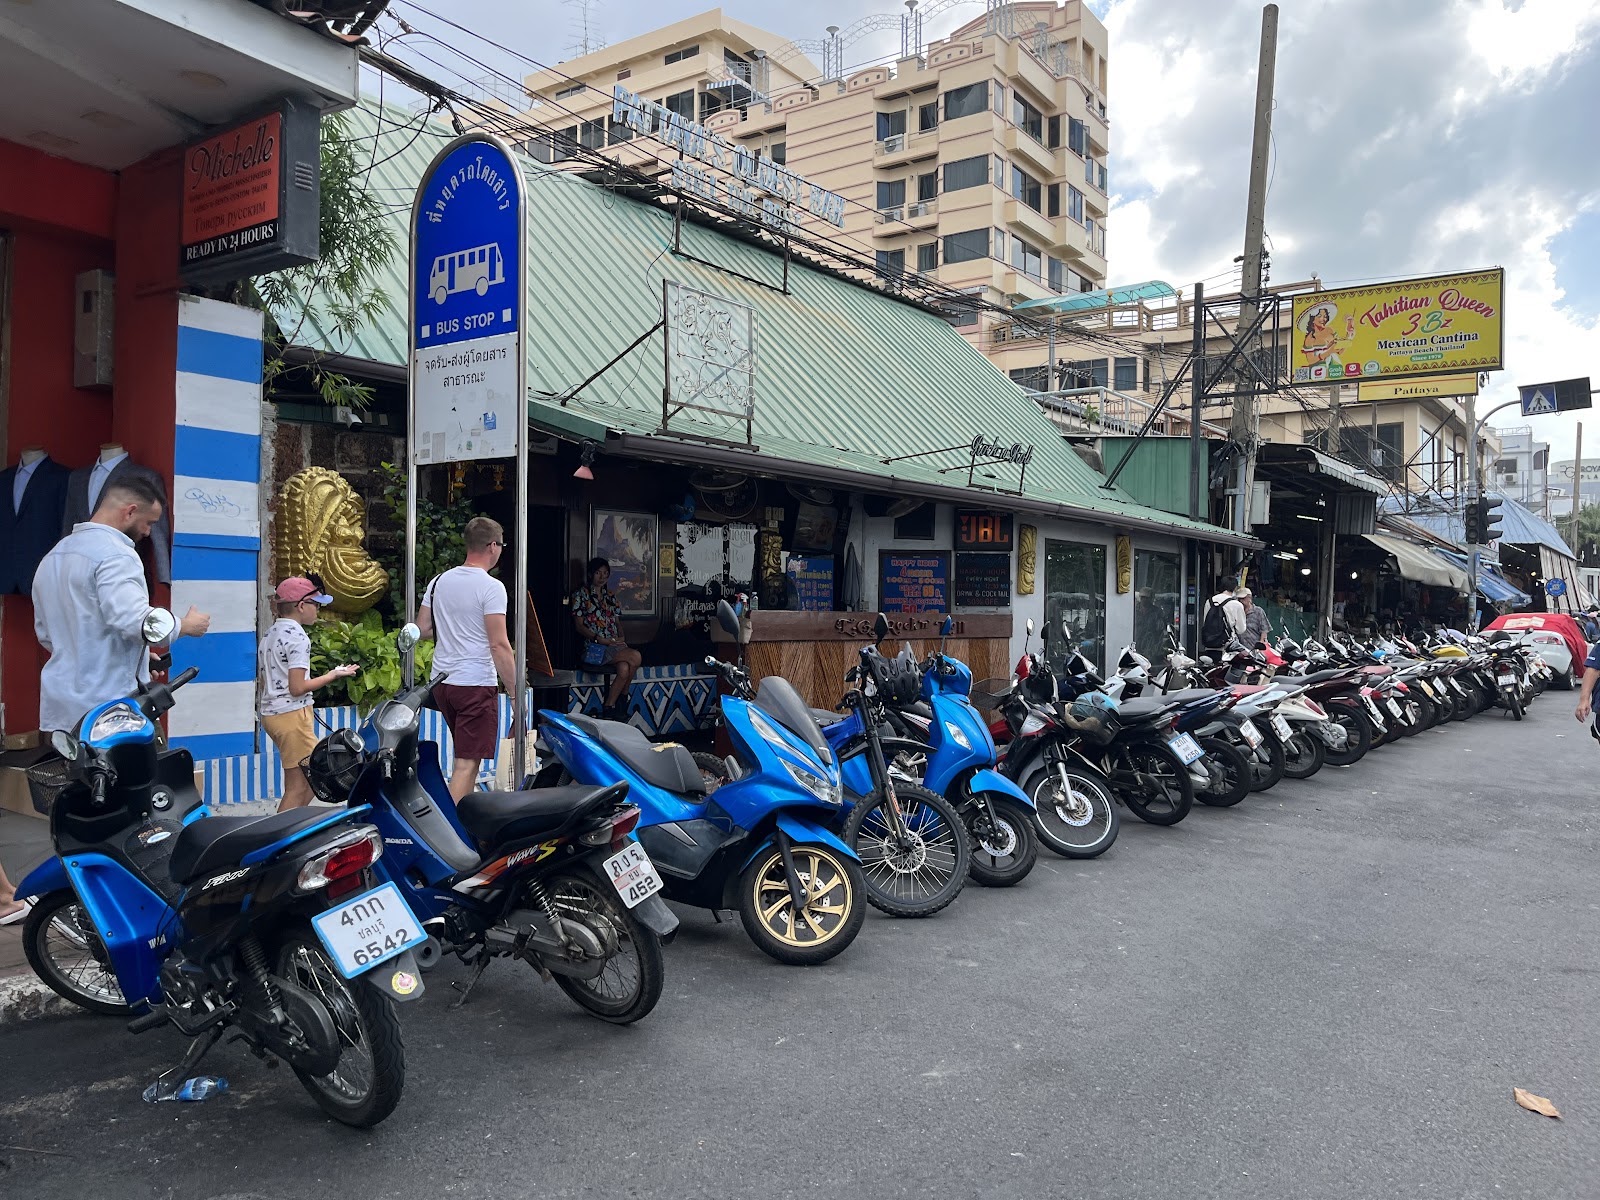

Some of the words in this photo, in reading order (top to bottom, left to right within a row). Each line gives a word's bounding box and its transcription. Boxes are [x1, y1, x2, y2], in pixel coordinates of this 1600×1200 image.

[191, 122, 274, 190] Michelle
[187, 240, 217, 261] READY
[218, 236, 229, 251] IN
[229, 233, 239, 250] 24
[240, 223, 274, 246] HOURS
[1359, 295, 1433, 328] Tahitian
[1438, 288, 1496, 318] Queen
[436, 318, 460, 336] BUS
[464, 311, 495, 331] STOP
[1377, 336, 1428, 350] Mexican
[1430, 331, 1480, 344] Cantina
[1389, 349, 1413, 357] Pattaya
[1414, 346, 1434, 354] Beach
[1435, 343, 1465, 353] Thailand
[424, 348, 507, 374] จุดรับ-ส่งผู้โดยสาร
[443, 371, 486, 388] สาธารณะ
[1394, 385, 1439, 396] Pattaya
[961, 515, 1009, 543] JBL
[900, 566, 907, 577] 4
[917, 559, 939, 567] HOUR
[686, 599, 716, 614] Pattaya's
[535, 838, 560, 863] S
[629, 875, 657, 901] 452
[340, 896, 385, 928] 4กก
[358, 918, 386, 940] ชลบุรี
[353, 928, 412, 966] 6542
